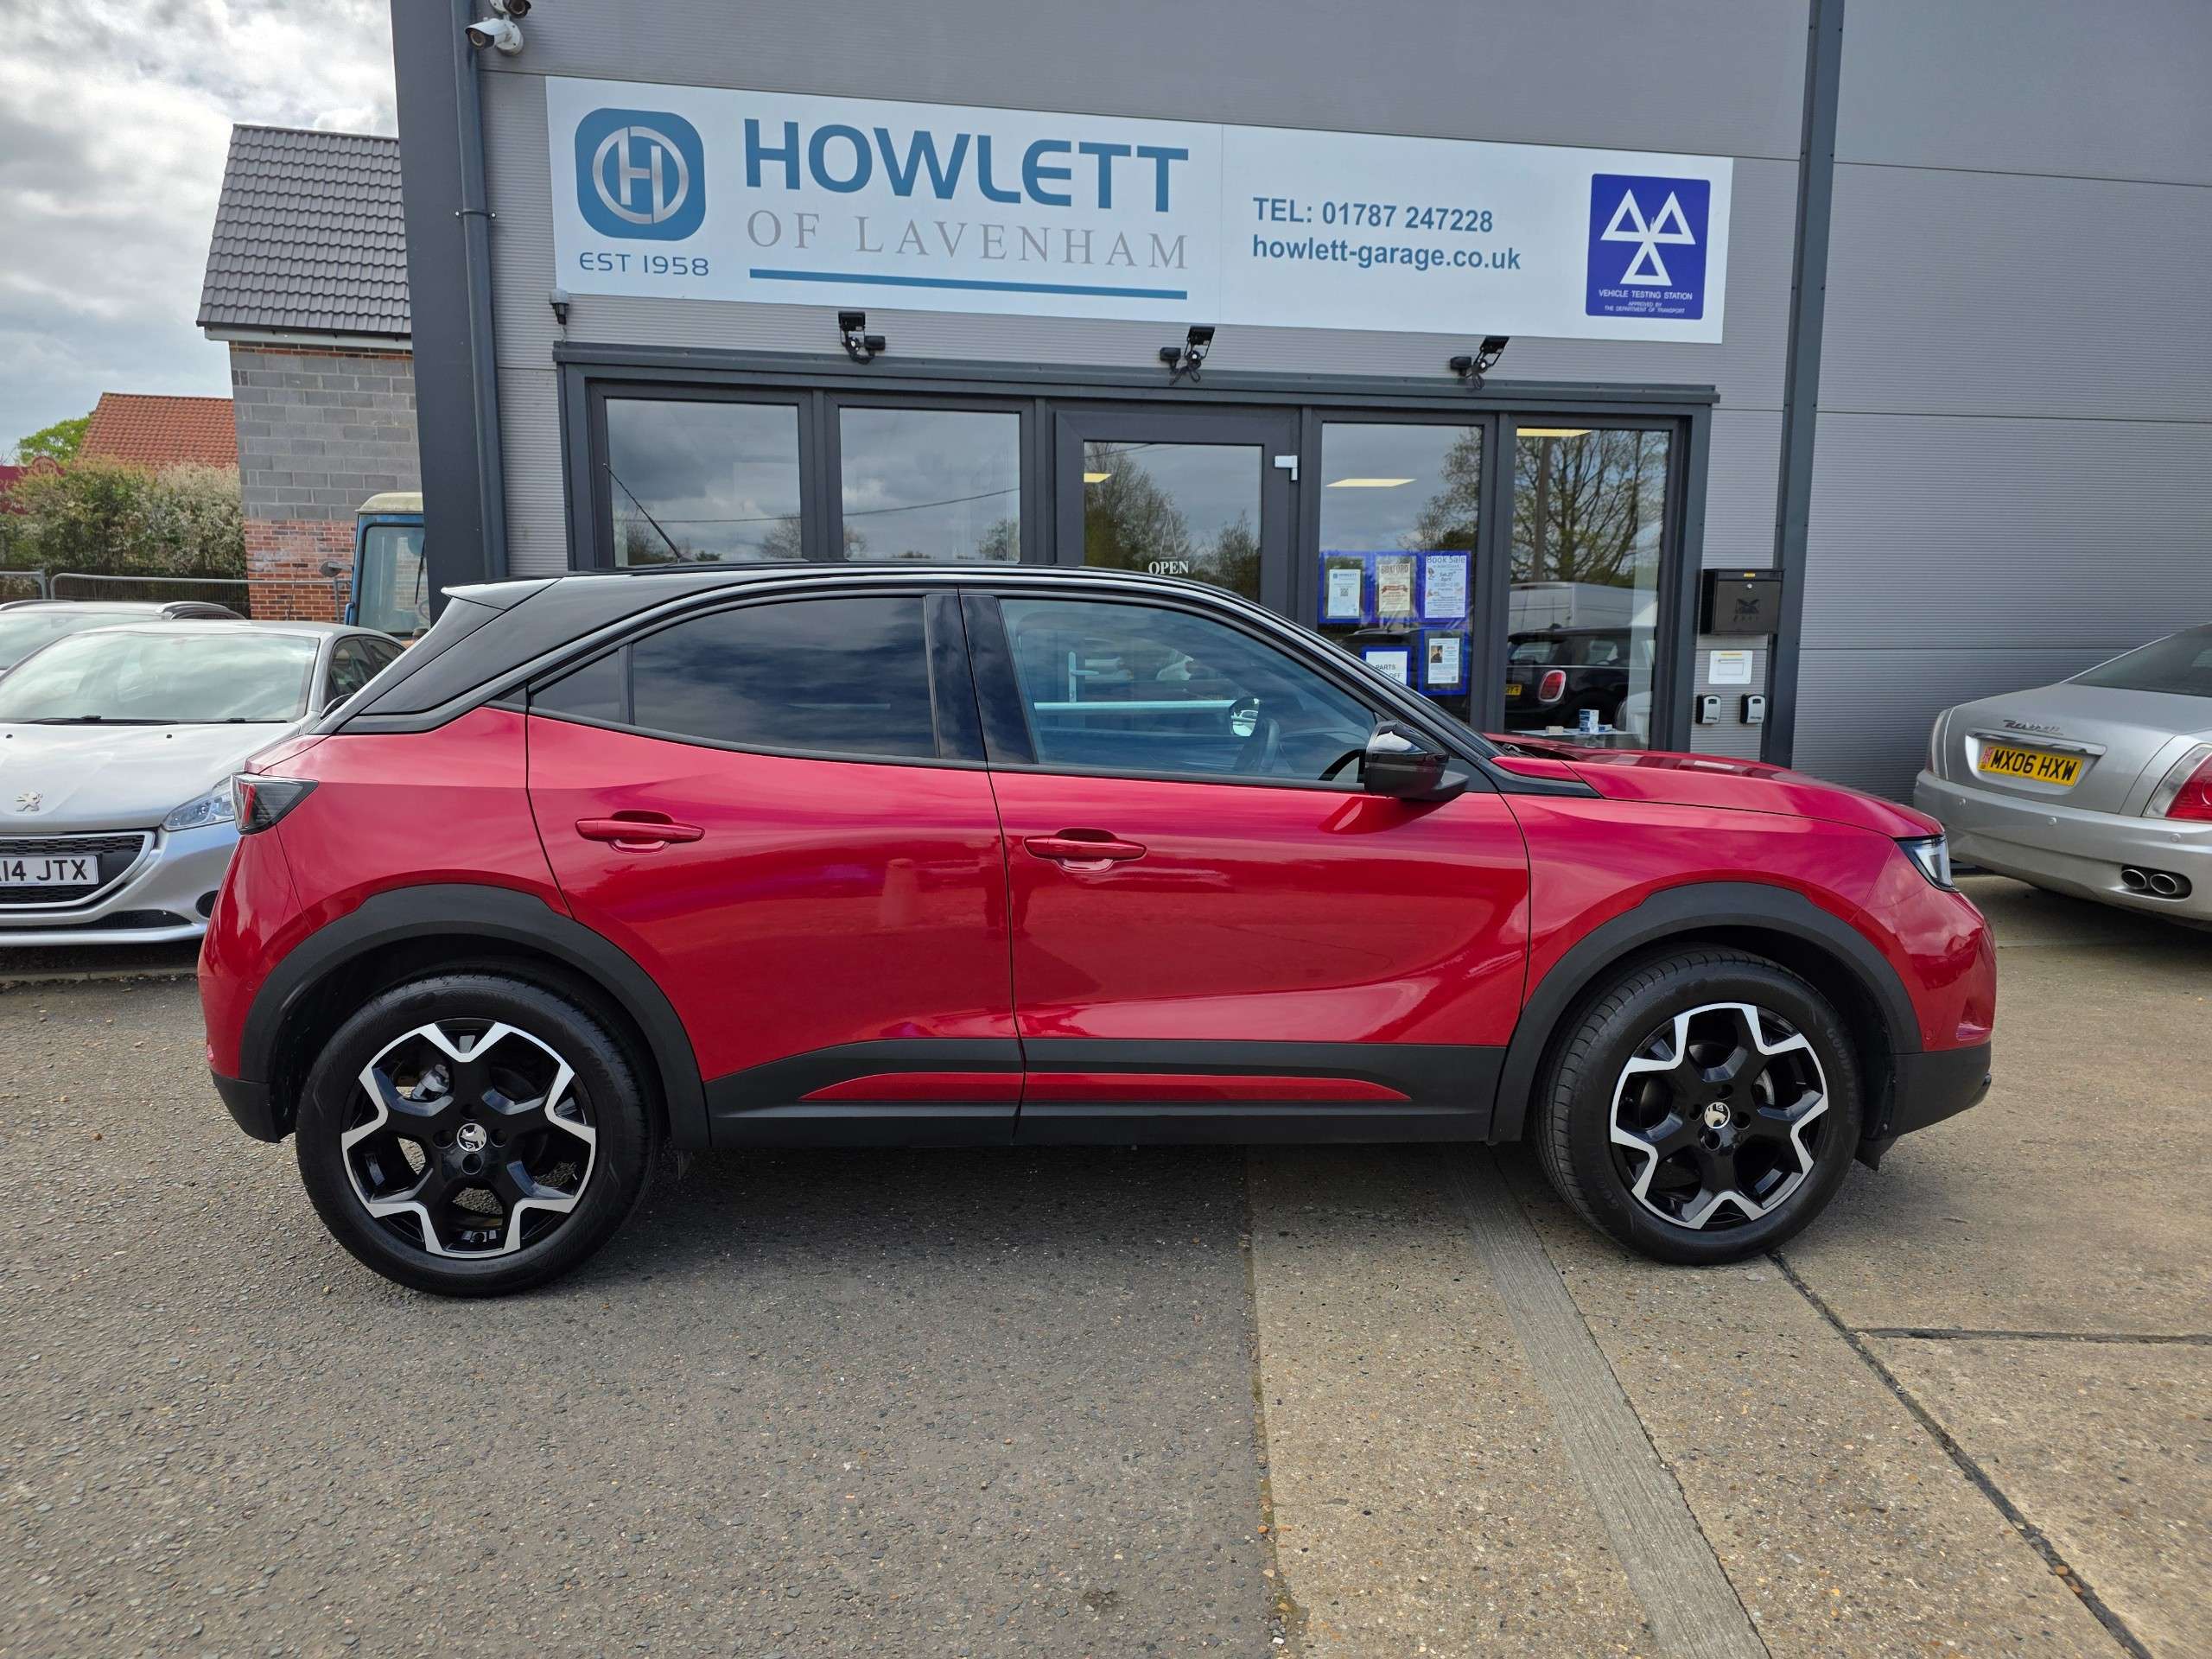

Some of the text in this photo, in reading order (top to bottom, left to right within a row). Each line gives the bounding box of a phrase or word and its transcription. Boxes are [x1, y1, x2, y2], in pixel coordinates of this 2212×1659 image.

[744, 118, 1189, 213] HOWLETT
[1252, 196, 1493, 233] TEL: 01787 247228
[747, 209, 1189, 270] OF LAVENHAM
[1252, 233, 1522, 271] howlett-garage.co.uk
[579, 251, 709, 276] EST 1958
[1631, 290, 1661, 299] TESTING
[1664, 291, 1693, 300] STATION
[1148, 560, 1189, 575] OPEN
[1427, 555, 1466, 564] Book Sale
[1990, 749, 2077, 781] MX06 HXW
[0, 859, 87, 881] 14 JTX
